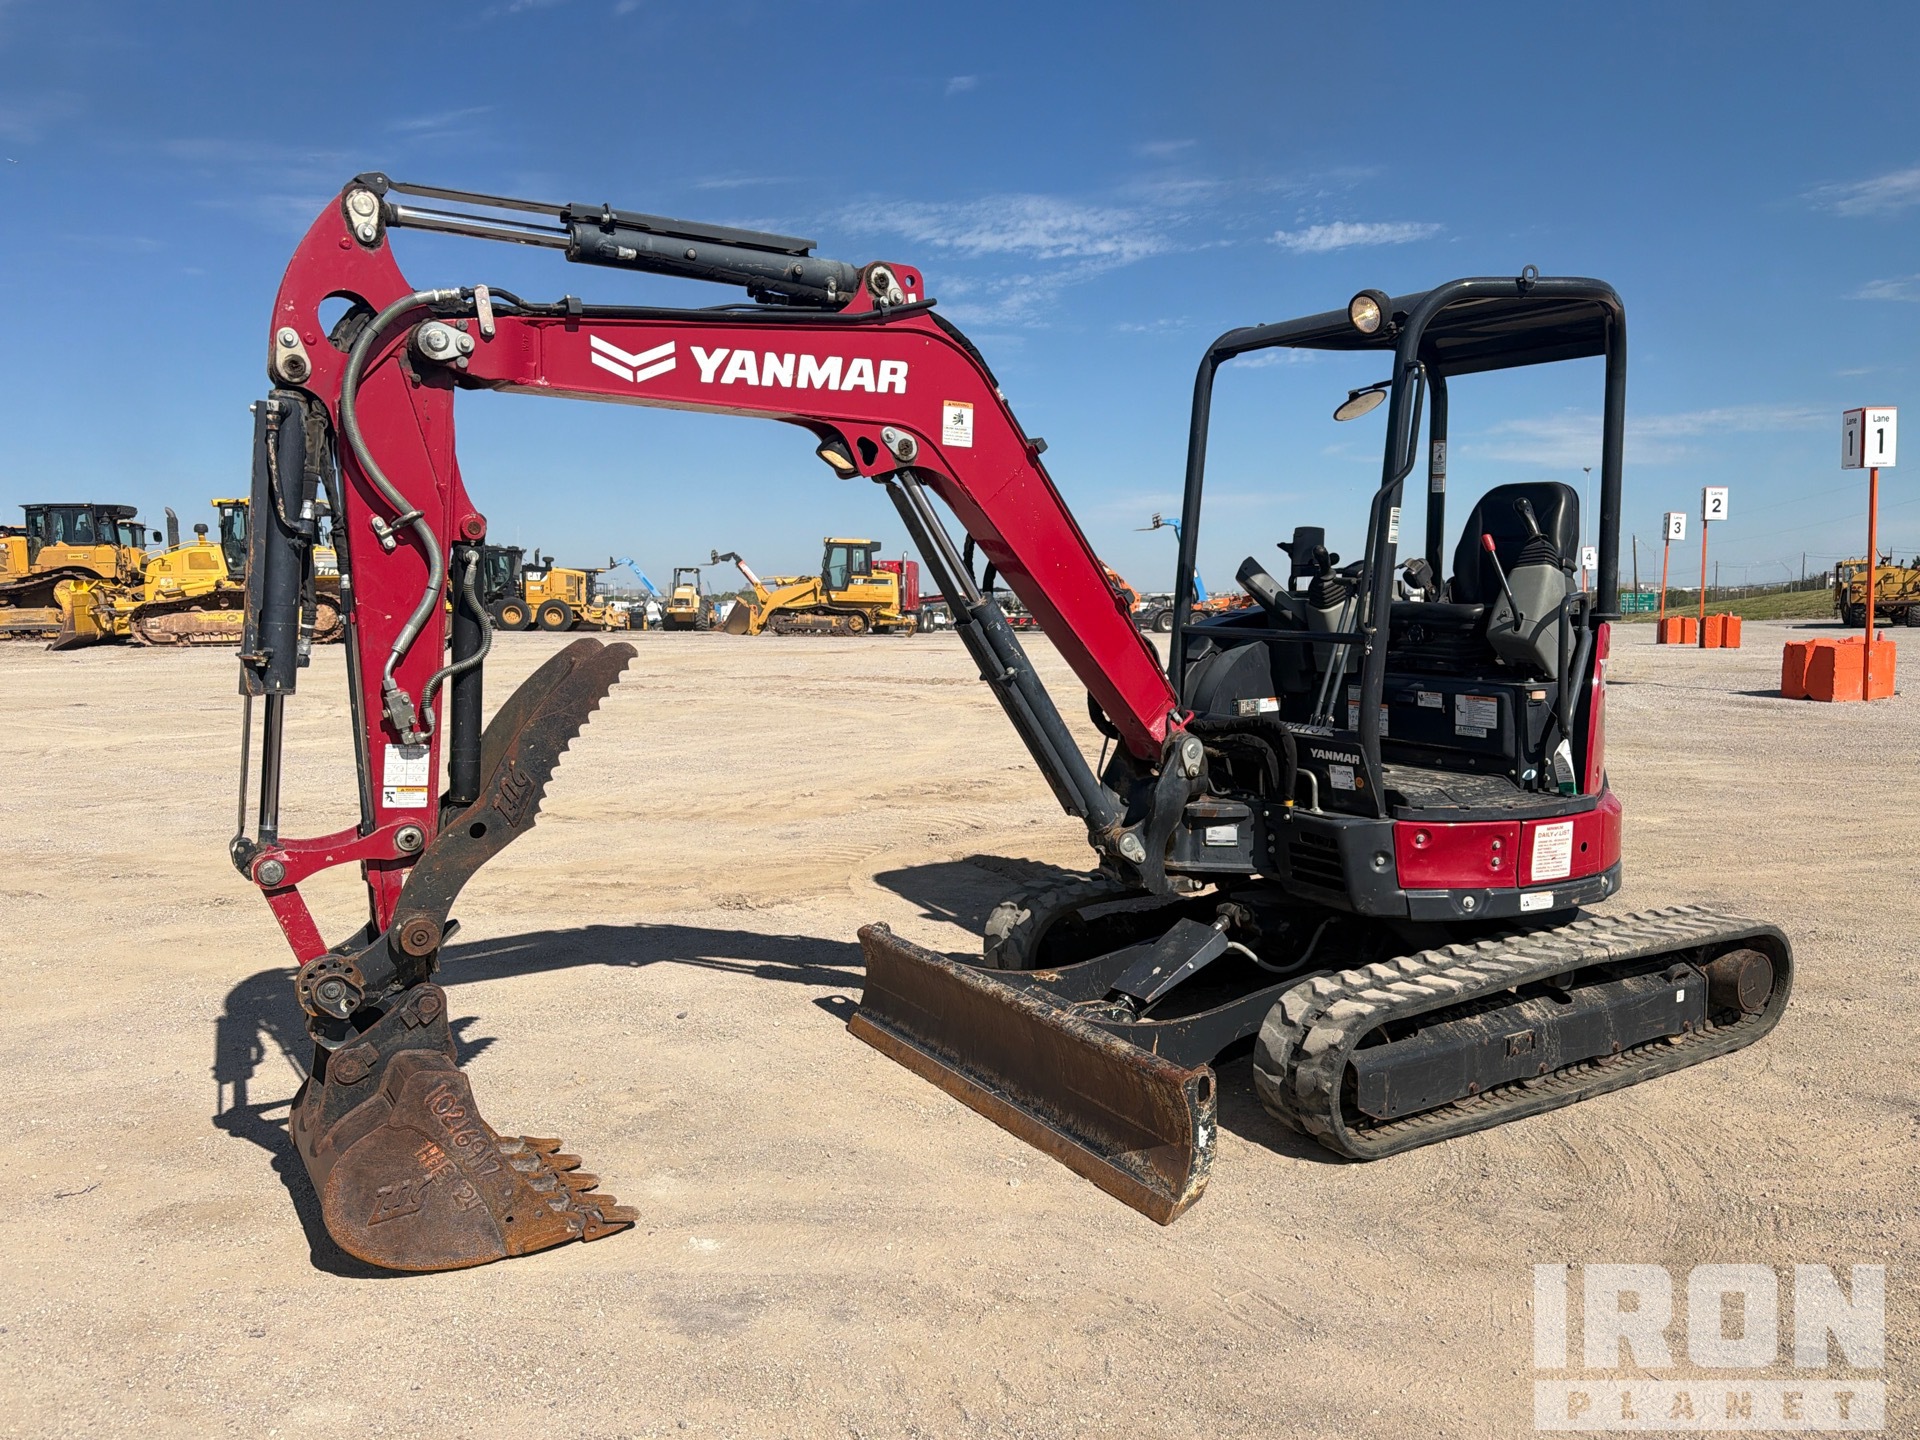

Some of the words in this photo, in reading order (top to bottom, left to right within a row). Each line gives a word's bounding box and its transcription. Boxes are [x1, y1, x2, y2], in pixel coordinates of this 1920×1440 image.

[690, 345, 909, 394] YANMAR
[1846, 417, 1857, 425] Lane
[1872, 414, 1890, 422] Lane
[1848, 430, 1853, 456] 1
[1876, 428, 1884, 454] 1
[1712, 498, 1721, 513] 2
[1674, 521, 1681, 534] 3
[1585, 552, 1591, 560] 4
[527, 571, 541, 580] CAT
[1310, 747, 1360, 765] YANMAR
